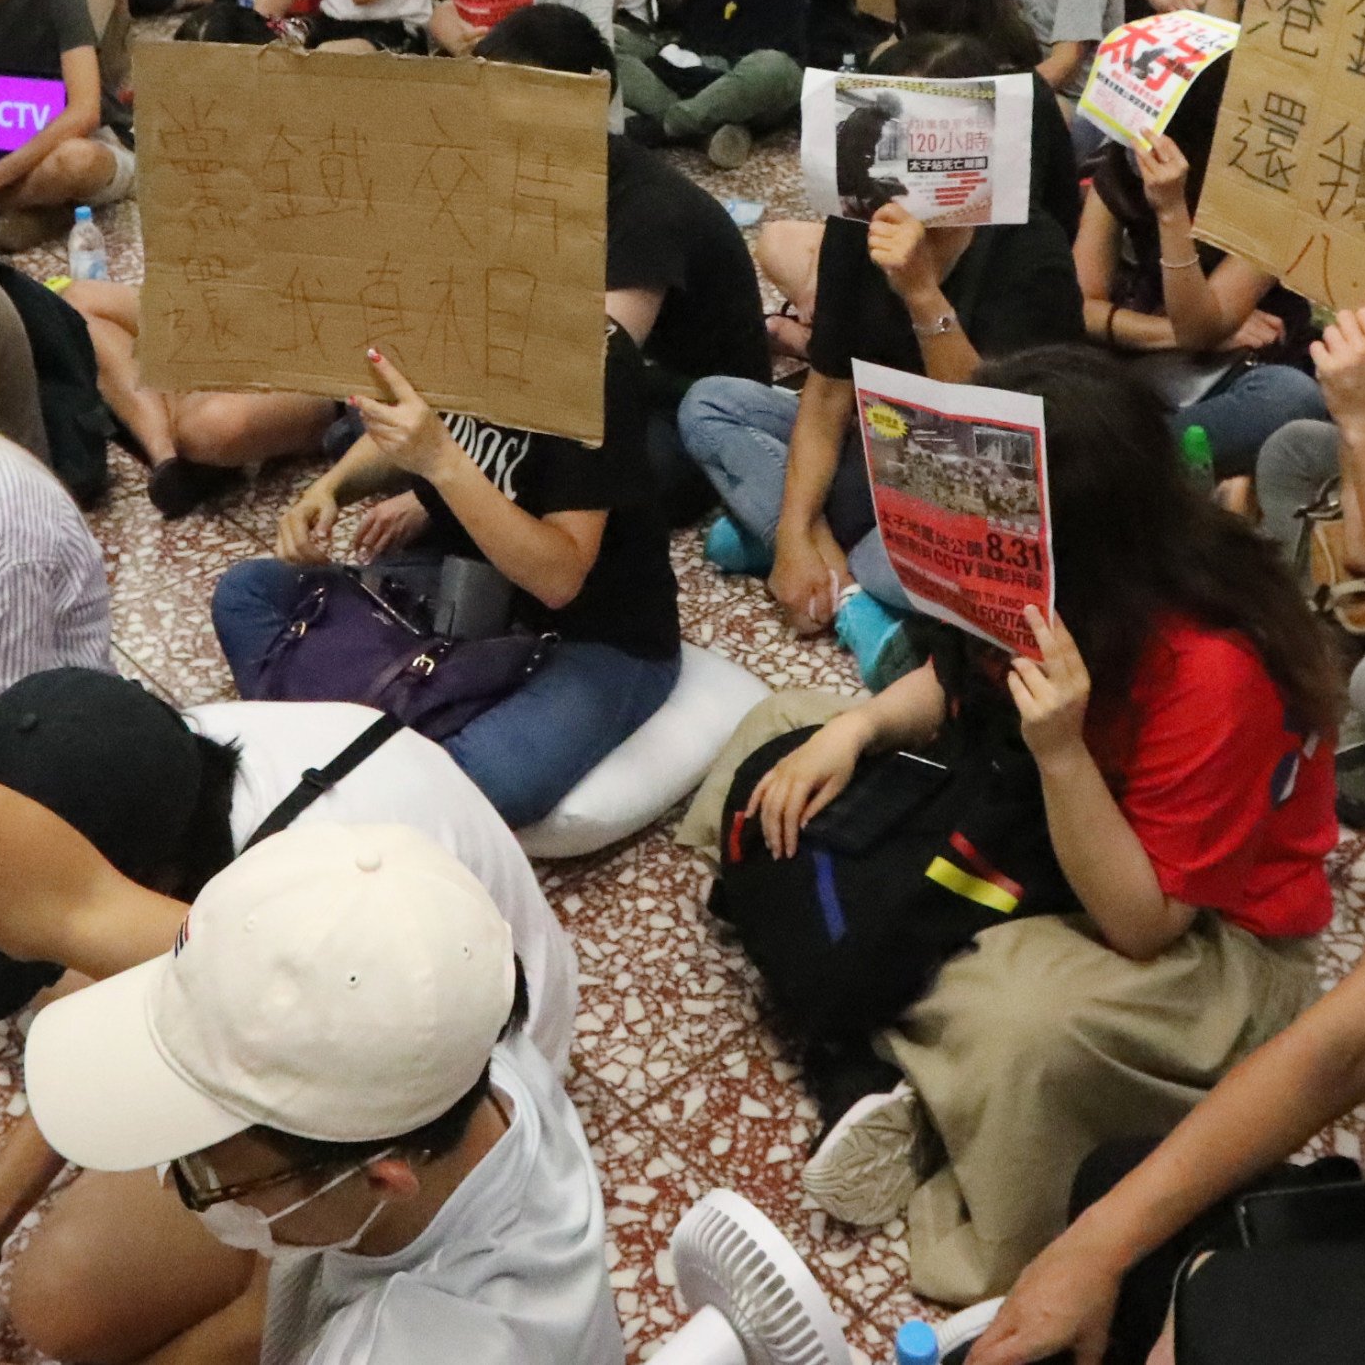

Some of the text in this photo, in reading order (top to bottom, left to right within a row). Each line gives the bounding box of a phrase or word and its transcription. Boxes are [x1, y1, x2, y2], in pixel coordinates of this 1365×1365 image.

[908, 130, 988, 154] 120小時
[933, 549, 974, 576] CCTV
[986, 532, 1043, 572] 8.31
[978, 605, 1030, 632] FOOTA
